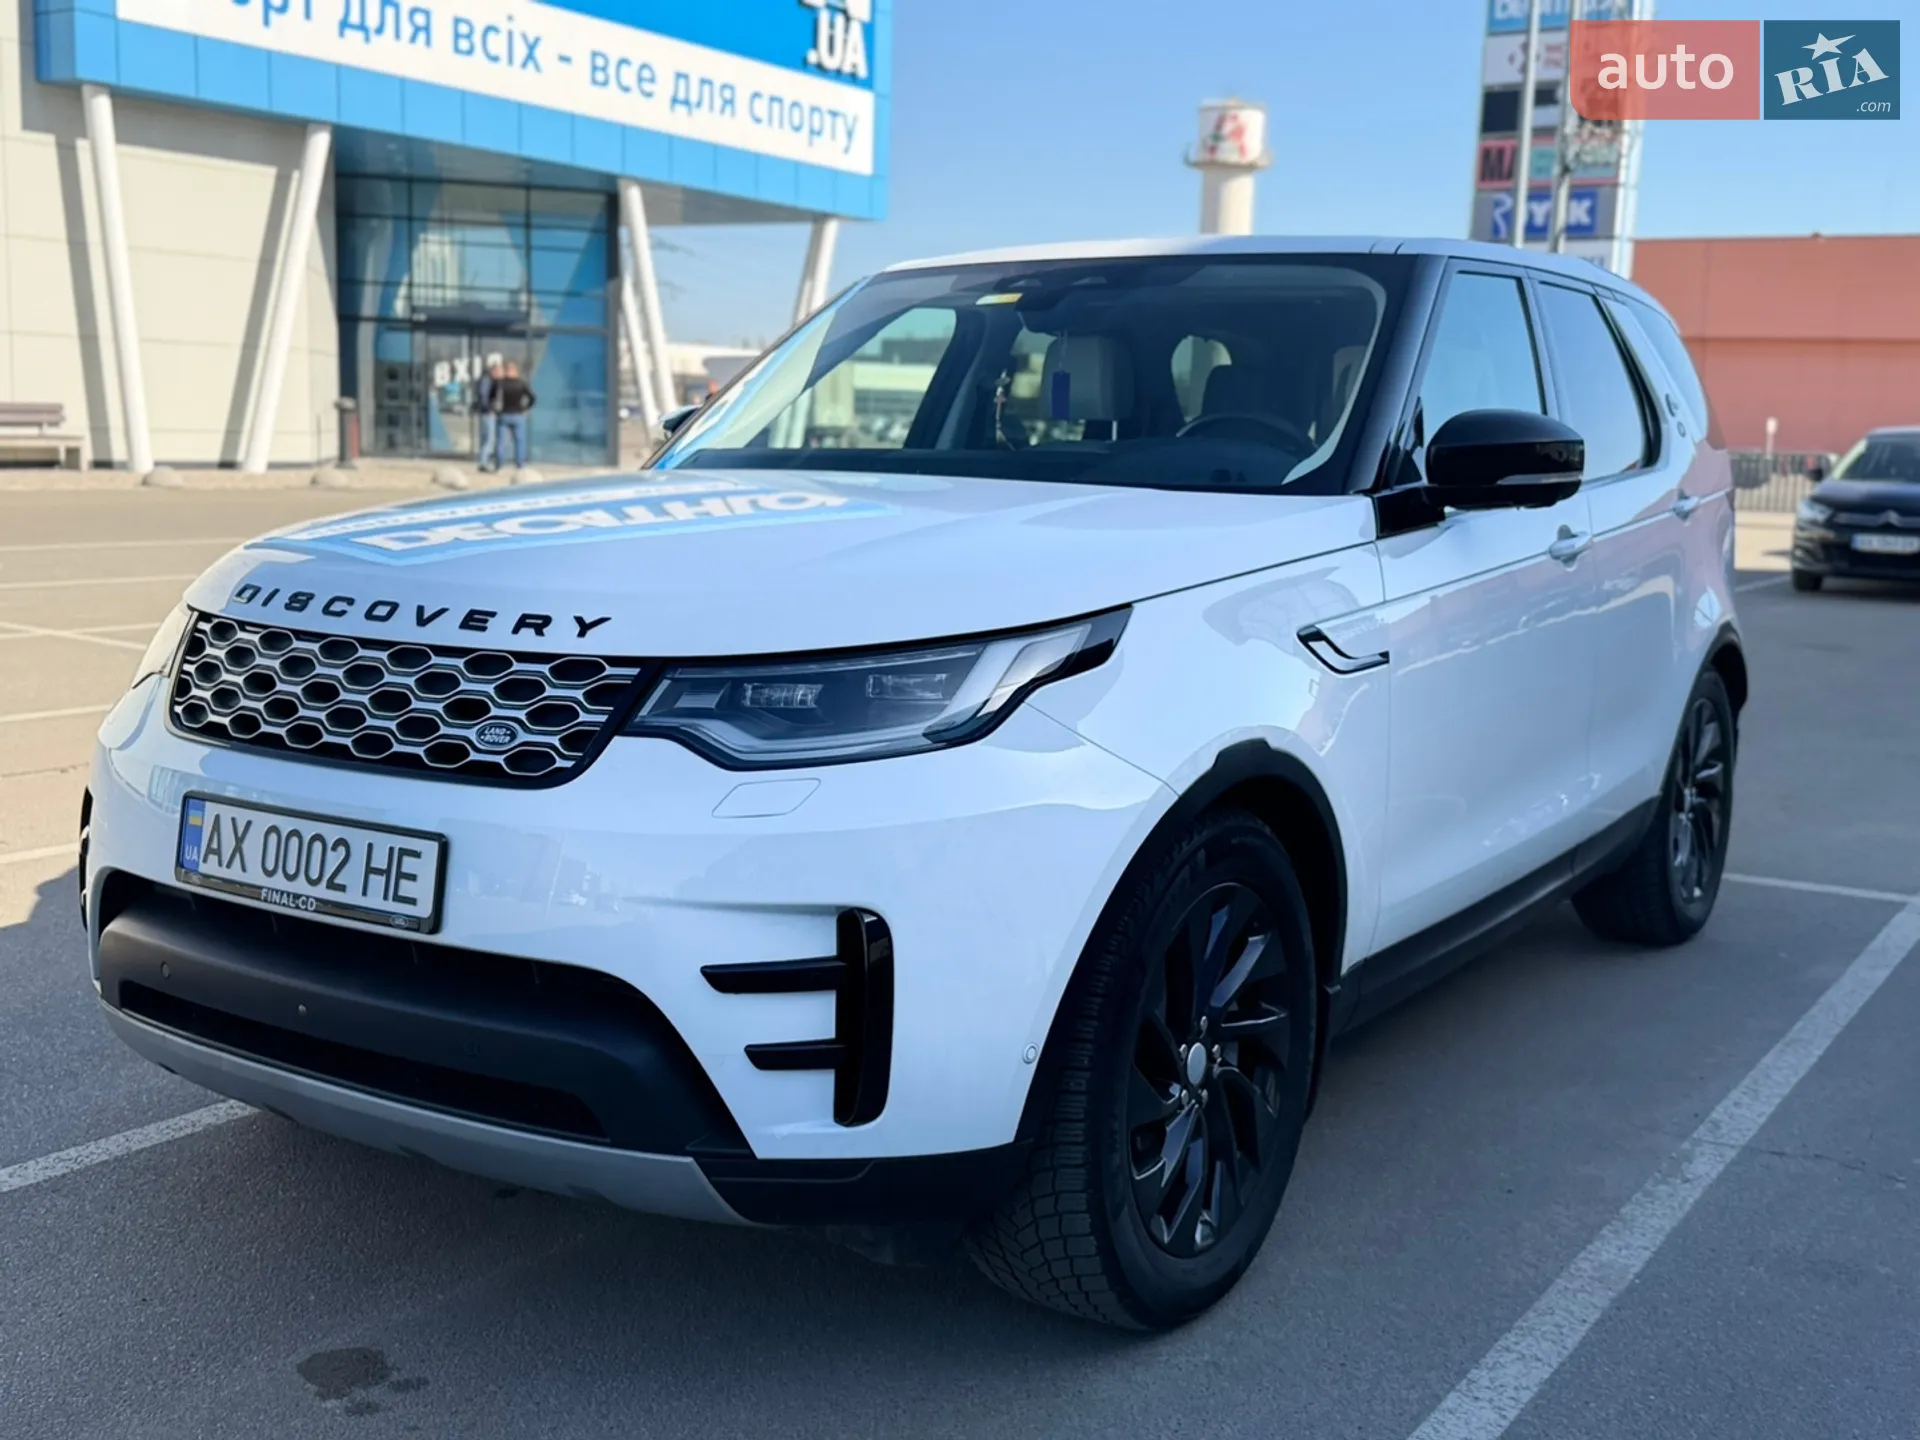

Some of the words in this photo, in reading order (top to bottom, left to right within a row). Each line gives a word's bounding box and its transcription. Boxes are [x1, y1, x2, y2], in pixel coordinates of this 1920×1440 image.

[452, 14, 542, 73] всіх
[589, 50, 657, 98] все
[670, 71, 736, 118] для
[748, 90, 857, 154] спорту
[234, 583, 612, 639] DISCOVERY
[184, 844, 199, 862] UA
[202, 813, 253, 873] AX
[261, 824, 351, 893] 0002
[361, 841, 422, 906] HE
